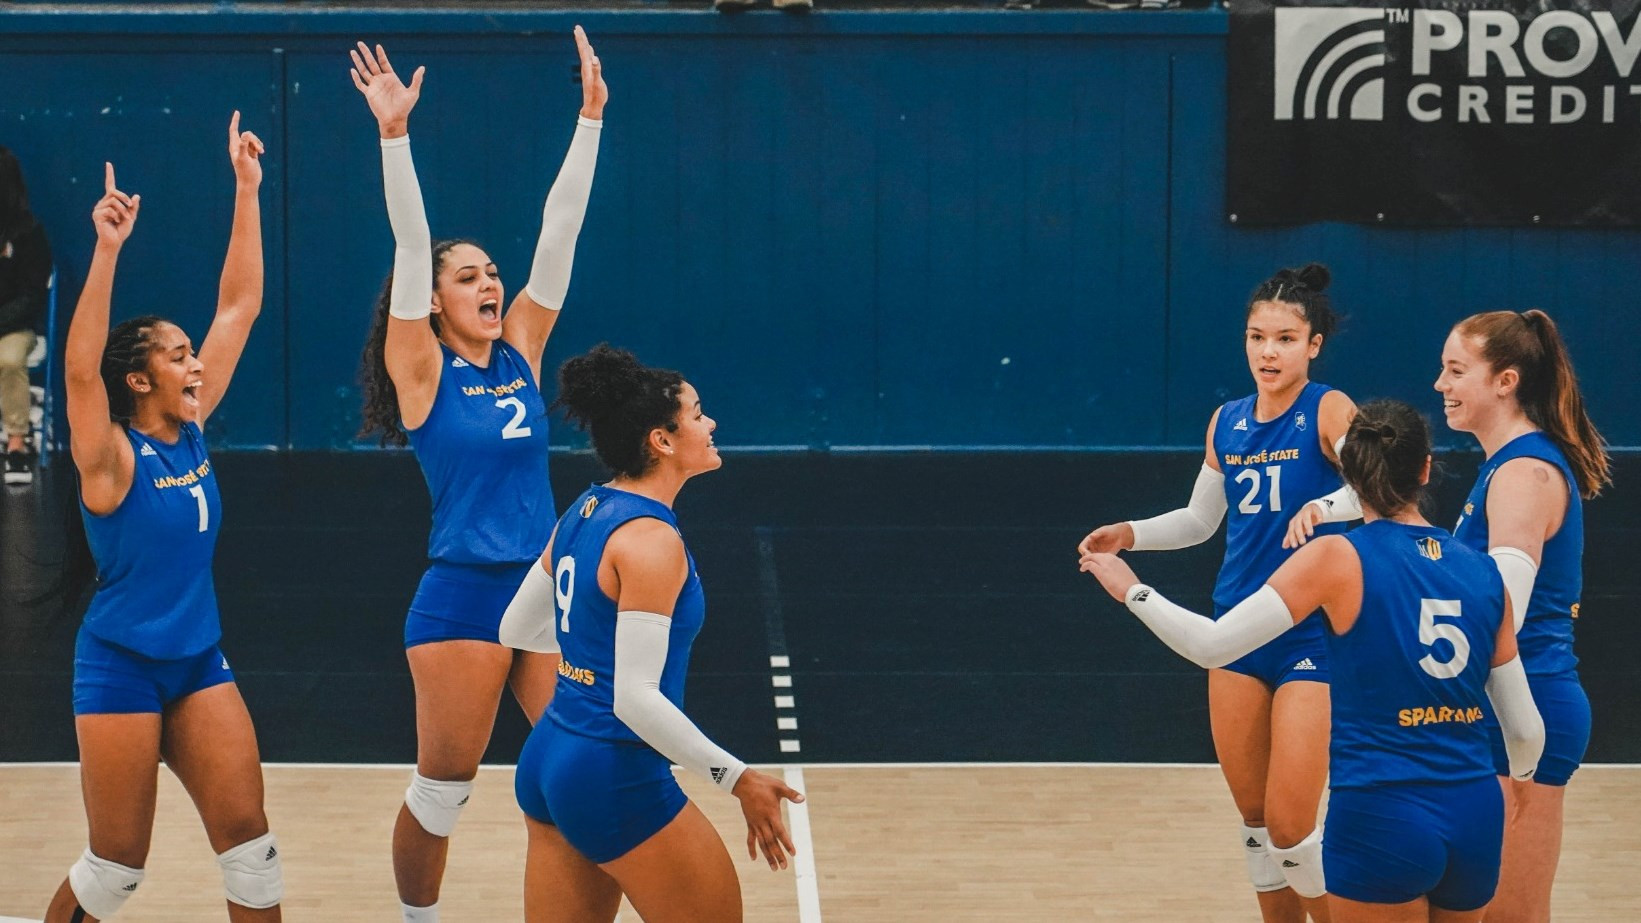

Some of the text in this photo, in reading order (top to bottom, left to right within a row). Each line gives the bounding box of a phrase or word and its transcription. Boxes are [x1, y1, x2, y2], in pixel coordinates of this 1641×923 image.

[1386, 8, 1410, 24] TM
[1411, 9, 1641, 78] PROV
[495, 396, 532, 440] 2
[174, 469, 199, 487] OSÉ
[1225, 449, 1299, 466] SAN JOSÉ STATE
[188, 484, 209, 533] 1
[1234, 465, 1282, 514] 21
[555, 555, 576, 633] 9
[1418, 598, 1471, 680] 5
